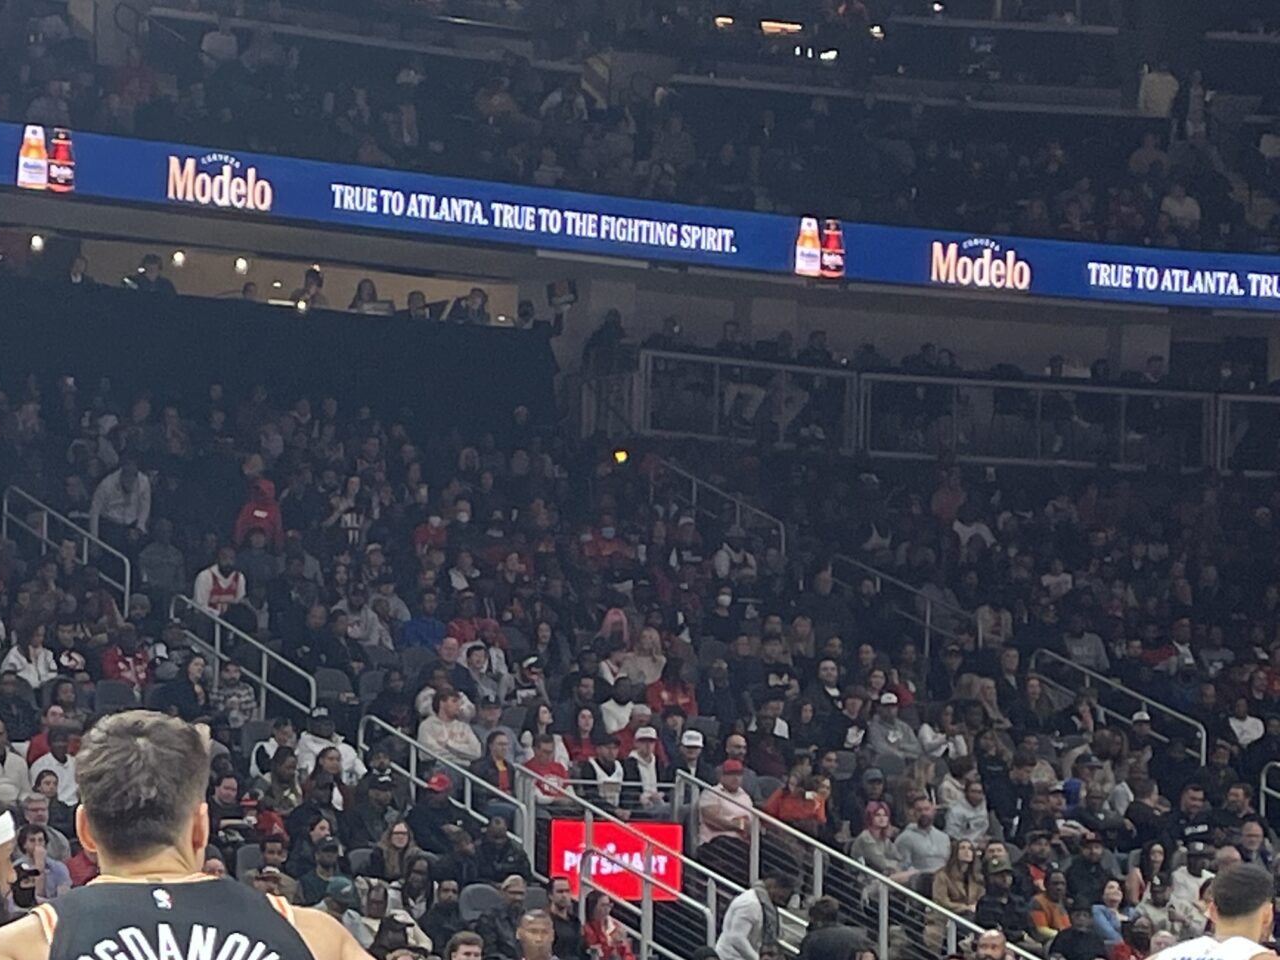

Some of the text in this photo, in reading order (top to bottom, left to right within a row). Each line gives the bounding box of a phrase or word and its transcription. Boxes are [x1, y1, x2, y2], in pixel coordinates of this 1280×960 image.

[167, 155, 272, 211] Modelo
[331, 183, 738, 253] TRUE TO ATLANTA. TRUE TO THE FIGHTING SPIRIT.
[931, 241, 1031, 290] Modelo
[1087, 261, 1133, 288] TRUE
[1135, 265, 1159, 290] TO
[1160, 268, 1245, 296] ATLANTA.
[563, 850, 668, 875] PTSMAT
